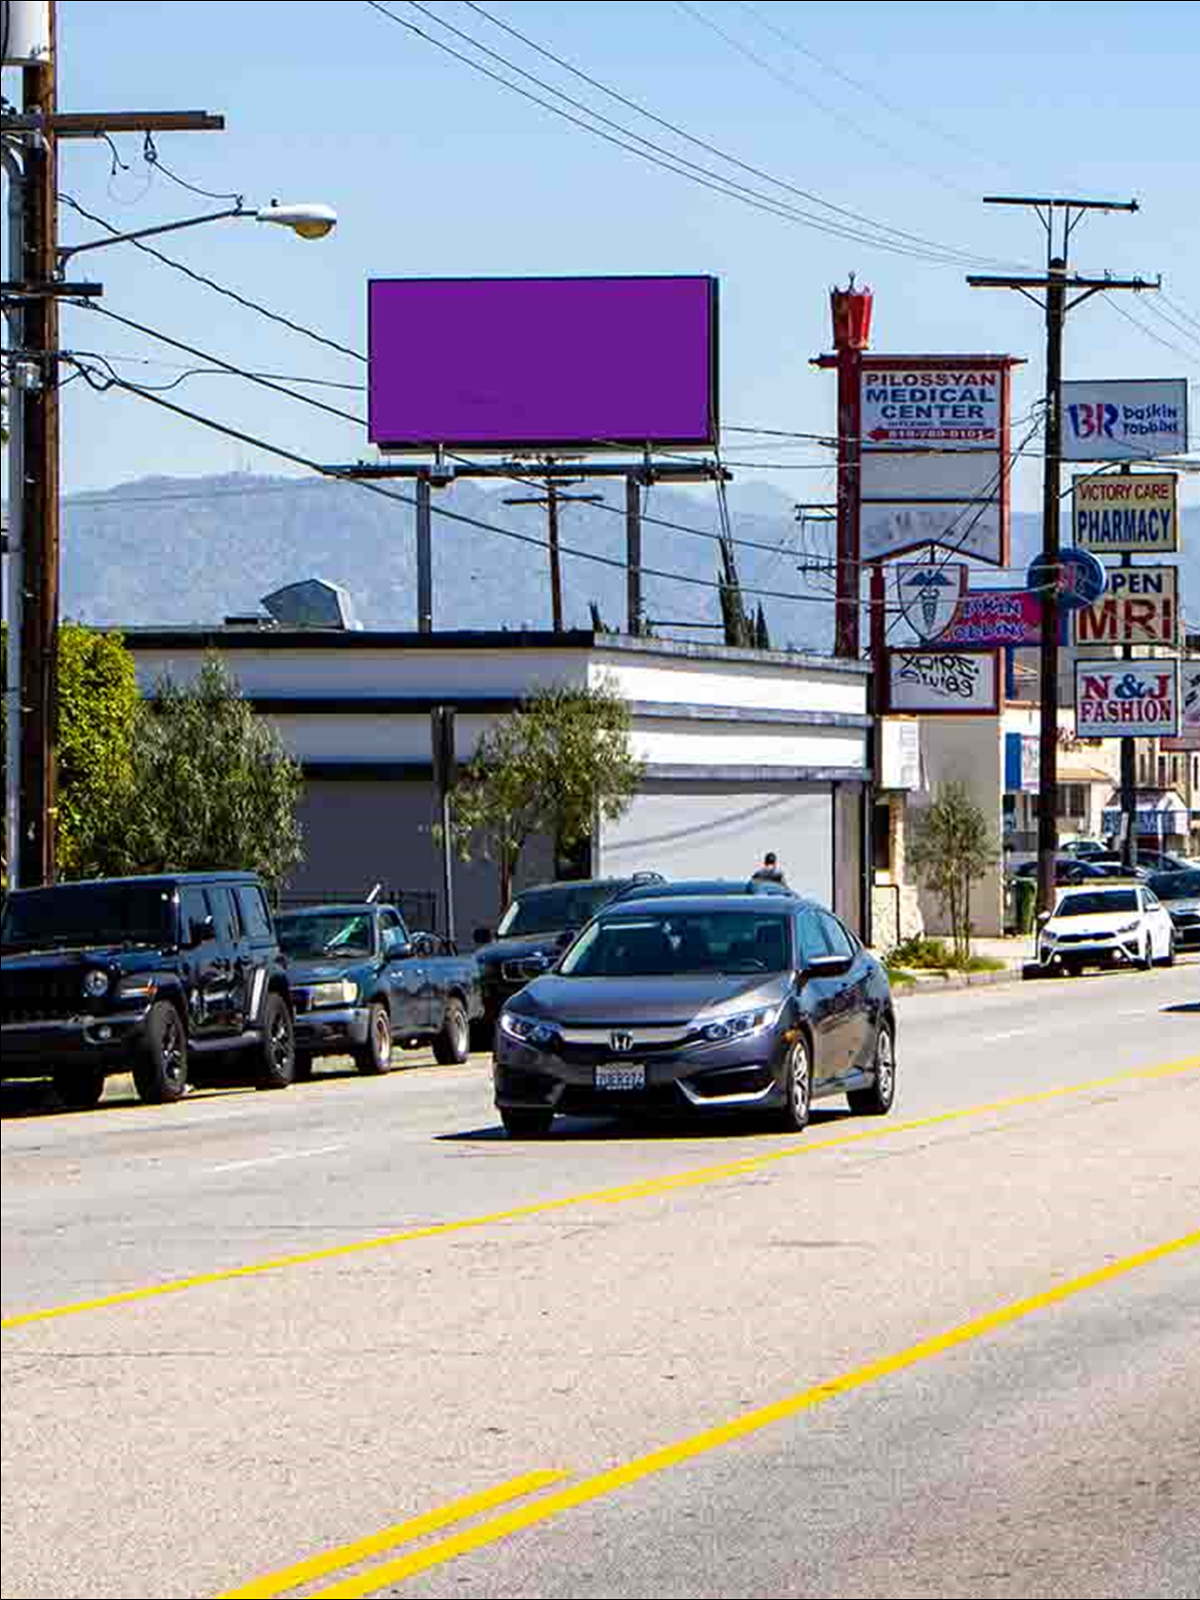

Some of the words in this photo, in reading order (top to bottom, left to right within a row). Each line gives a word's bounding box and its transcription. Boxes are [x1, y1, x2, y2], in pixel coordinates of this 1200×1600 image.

[865, 373, 997, 387] PILOSSYAN
[865, 388, 995, 403] MEDICAL
[880, 404, 985, 419] CENTER
[1066, 403, 1119, 439] BR
[1078, 484, 1132, 500] VICTORY
[1134, 483, 1170, 500] CARE
[1077, 508, 1171, 544] PHARMACY
[1078, 598, 1173, 641] MRI
[1080, 674, 1112, 700] N
[1114, 672, 1147, 700] &
[1149, 674, 1172, 700] J
[1080, 700, 1173, 724] FASHION
